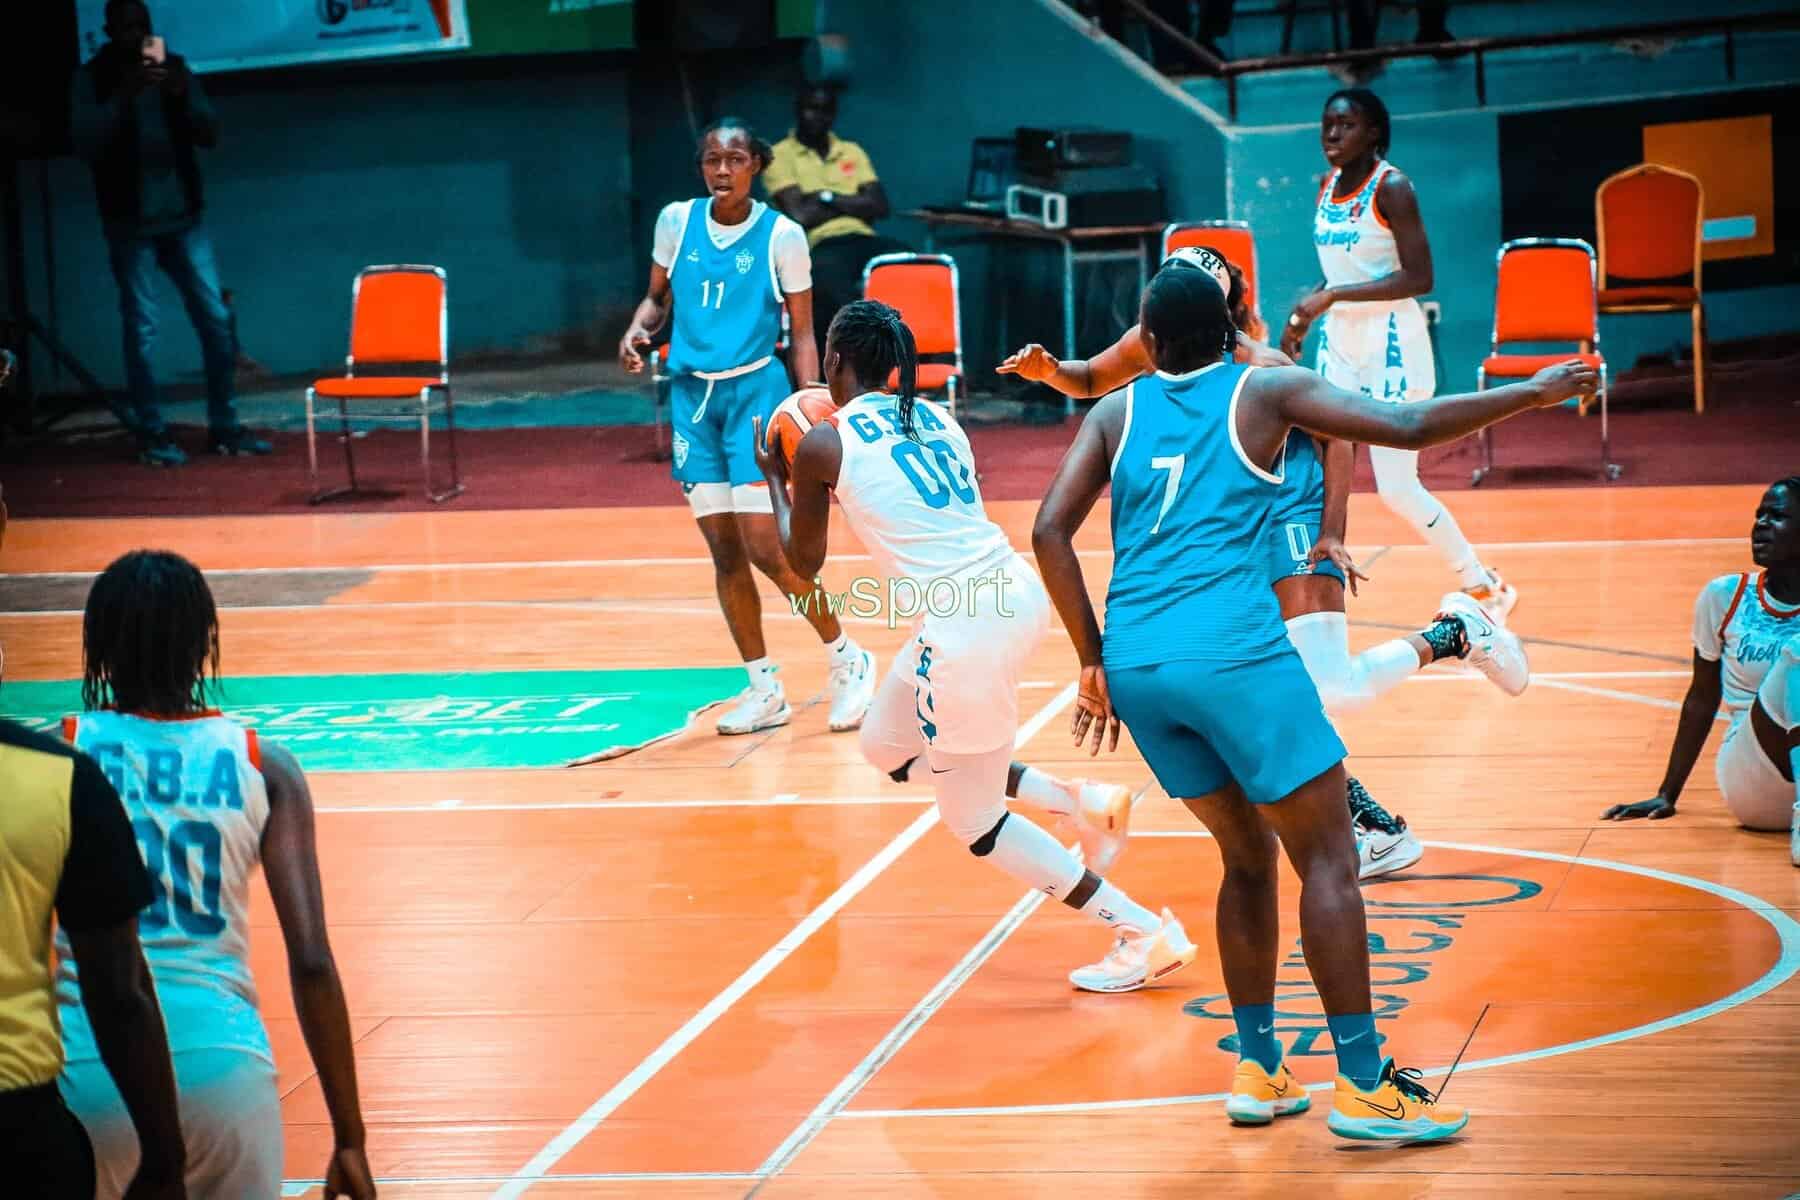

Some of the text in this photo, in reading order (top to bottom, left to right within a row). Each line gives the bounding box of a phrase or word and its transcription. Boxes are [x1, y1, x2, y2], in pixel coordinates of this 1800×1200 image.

[701, 280, 725, 309] 11
[891, 440, 976, 509] 00
[1150, 453, 1185, 534] 7
[90, 743, 243, 809] G.B.A
